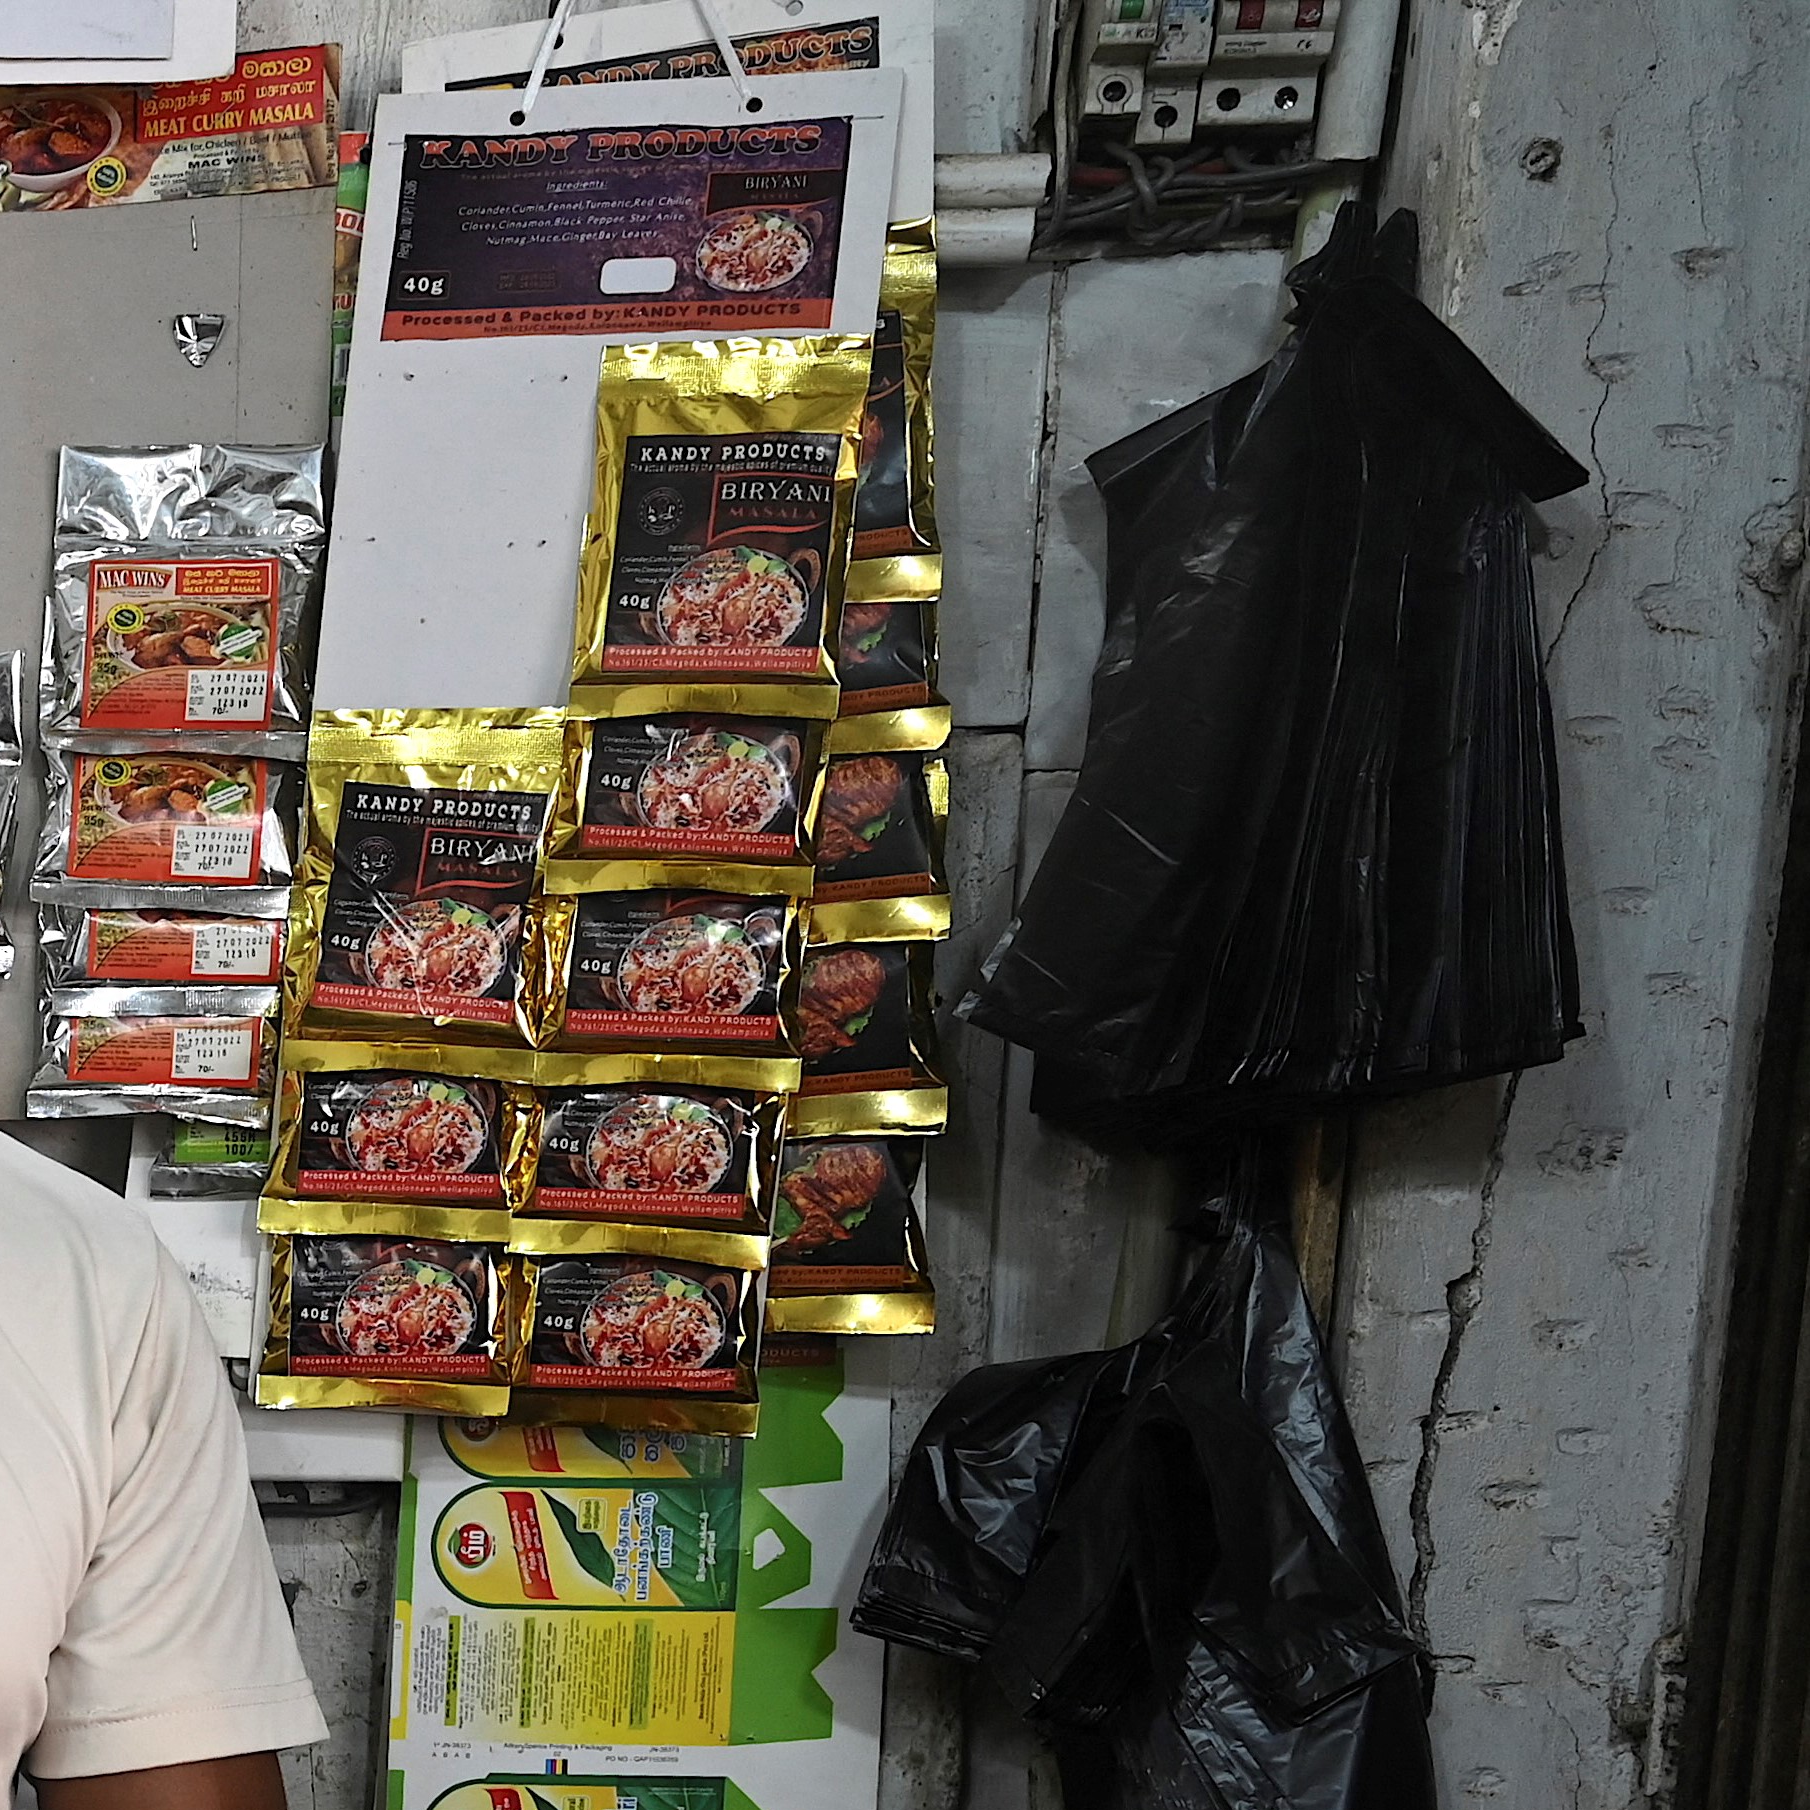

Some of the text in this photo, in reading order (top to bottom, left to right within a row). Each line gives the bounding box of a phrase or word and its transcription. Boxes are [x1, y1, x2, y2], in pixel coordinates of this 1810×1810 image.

[145, 102, 314, 138] MEAT CURRY MASALA
[420, 126, 822, 168] KANDY PRODUCTS
[188, 155, 266, 169] MAC WINS
[745, 174, 807, 190] BIRYANI
[630, 213, 651, 222] Star
[404, 276, 444, 297] 40g
[402, 311, 494, 326] Processed
[520, 309, 587, 324] Packed
[623, 305, 687, 319] KANDY
[697, 302, 800, 317] PRODUCTS
[641, 445, 825, 461] KANDY PRODUCTS
[721, 480, 830, 503] BIRYANI
[730, 507, 816, 520] MASALA
[99, 571, 165, 588] MAC WINS
[231, 585, 261, 593] MASALA
[619, 595, 650, 609] 40g
[610, 647, 812, 658] Processed Packed PRODUCTS
[600, 774, 631, 790] 40g
[357, 794, 532, 821] KANDY PRODUCTS
[590, 826, 791, 845] Processed Packed KANDY PRODUCTS
[431, 838, 536, 864] BIRYANI
[331, 935, 361, 950] 40g
[580, 959, 611, 974] 40g
[571, 1010, 771, 1026] Processed Packed PRODUCTS
[310, 1120, 339, 1135] 40g
[549, 1136, 579, 1152] 40g
[445, 1175, 494, 1184] PRODUCTS
[300, 1307, 330, 1322] 40g
[543, 1314, 573, 1330] 40g
[402, 1356, 486, 1364] KANDY PRODUCTS
